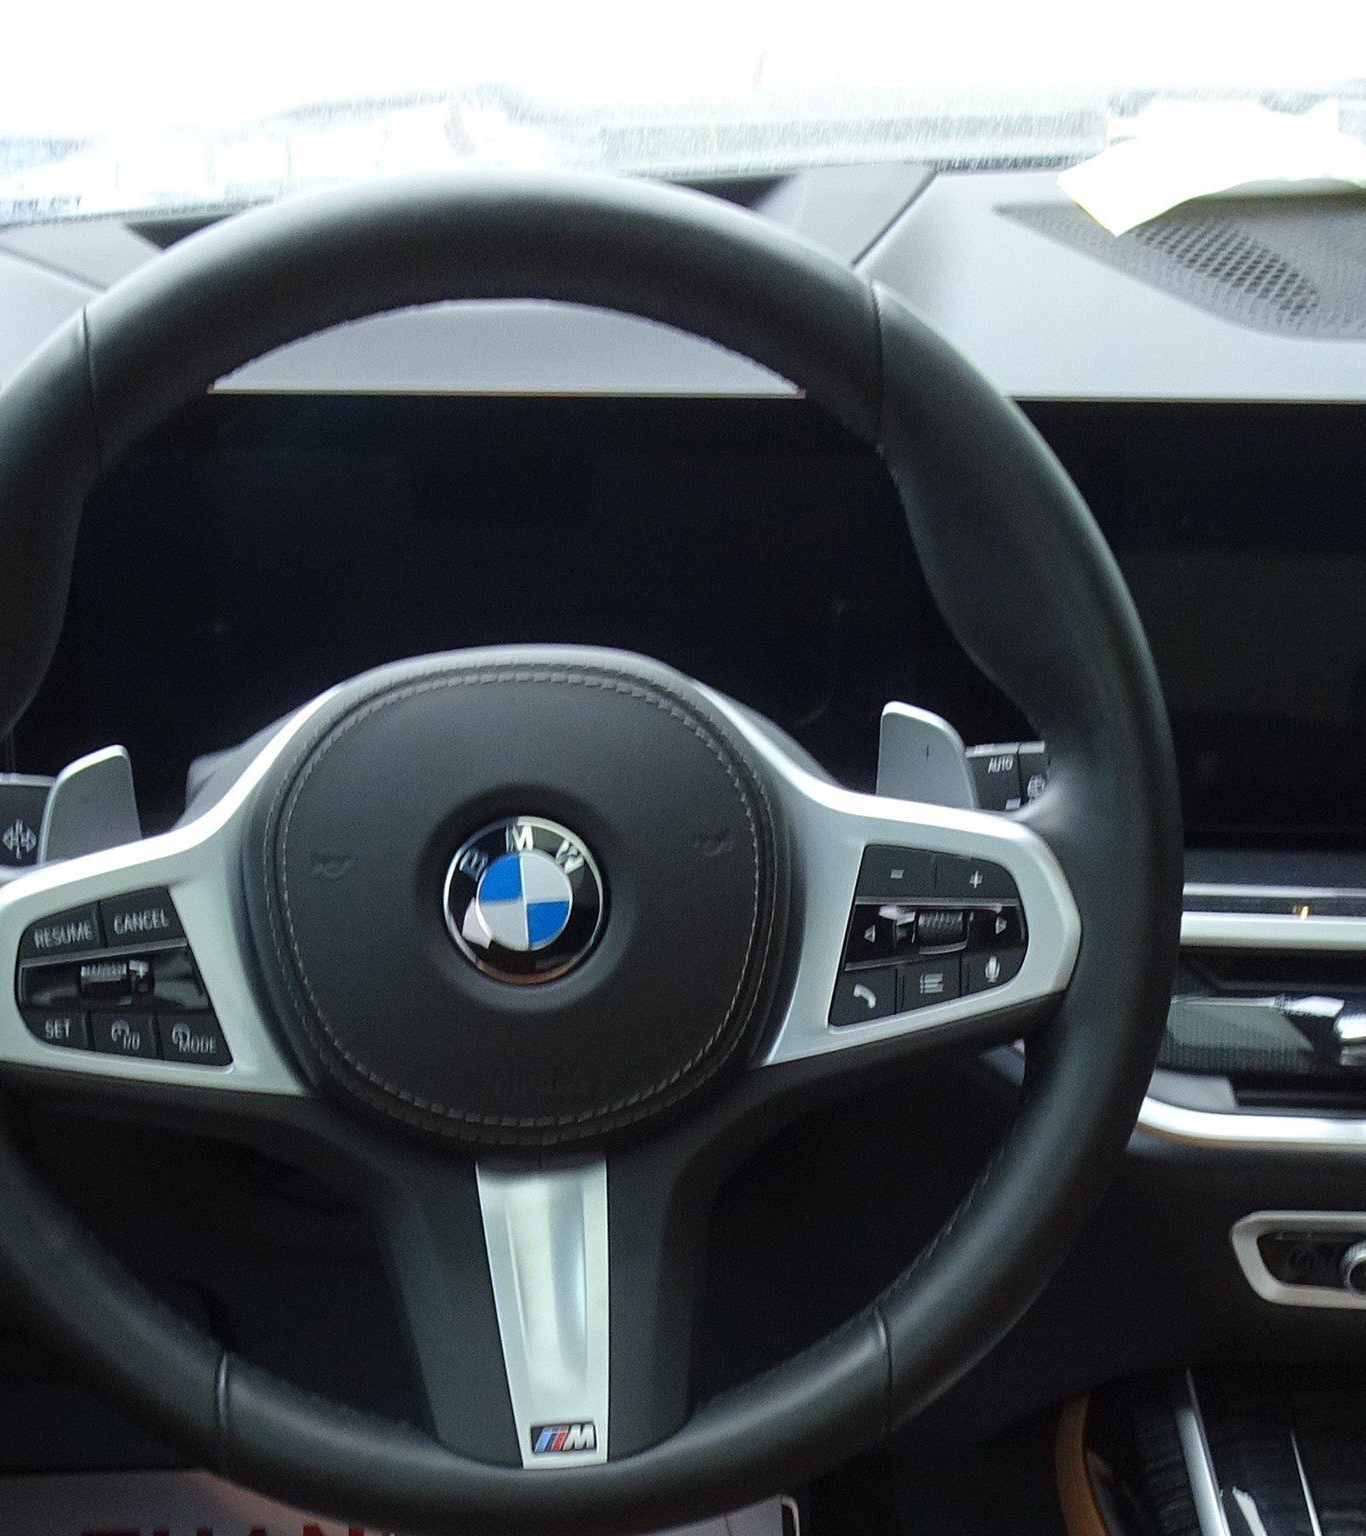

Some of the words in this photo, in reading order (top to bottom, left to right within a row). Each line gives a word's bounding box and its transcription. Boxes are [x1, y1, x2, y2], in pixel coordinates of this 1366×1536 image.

[458, 824, 586, 883] BMW
[34, 921, 94, 949] RESUME
[112, 907, 170, 935] CANCEL
[44, 1017, 72, 1039] SET
[178, 1032, 218, 1055] MODE
